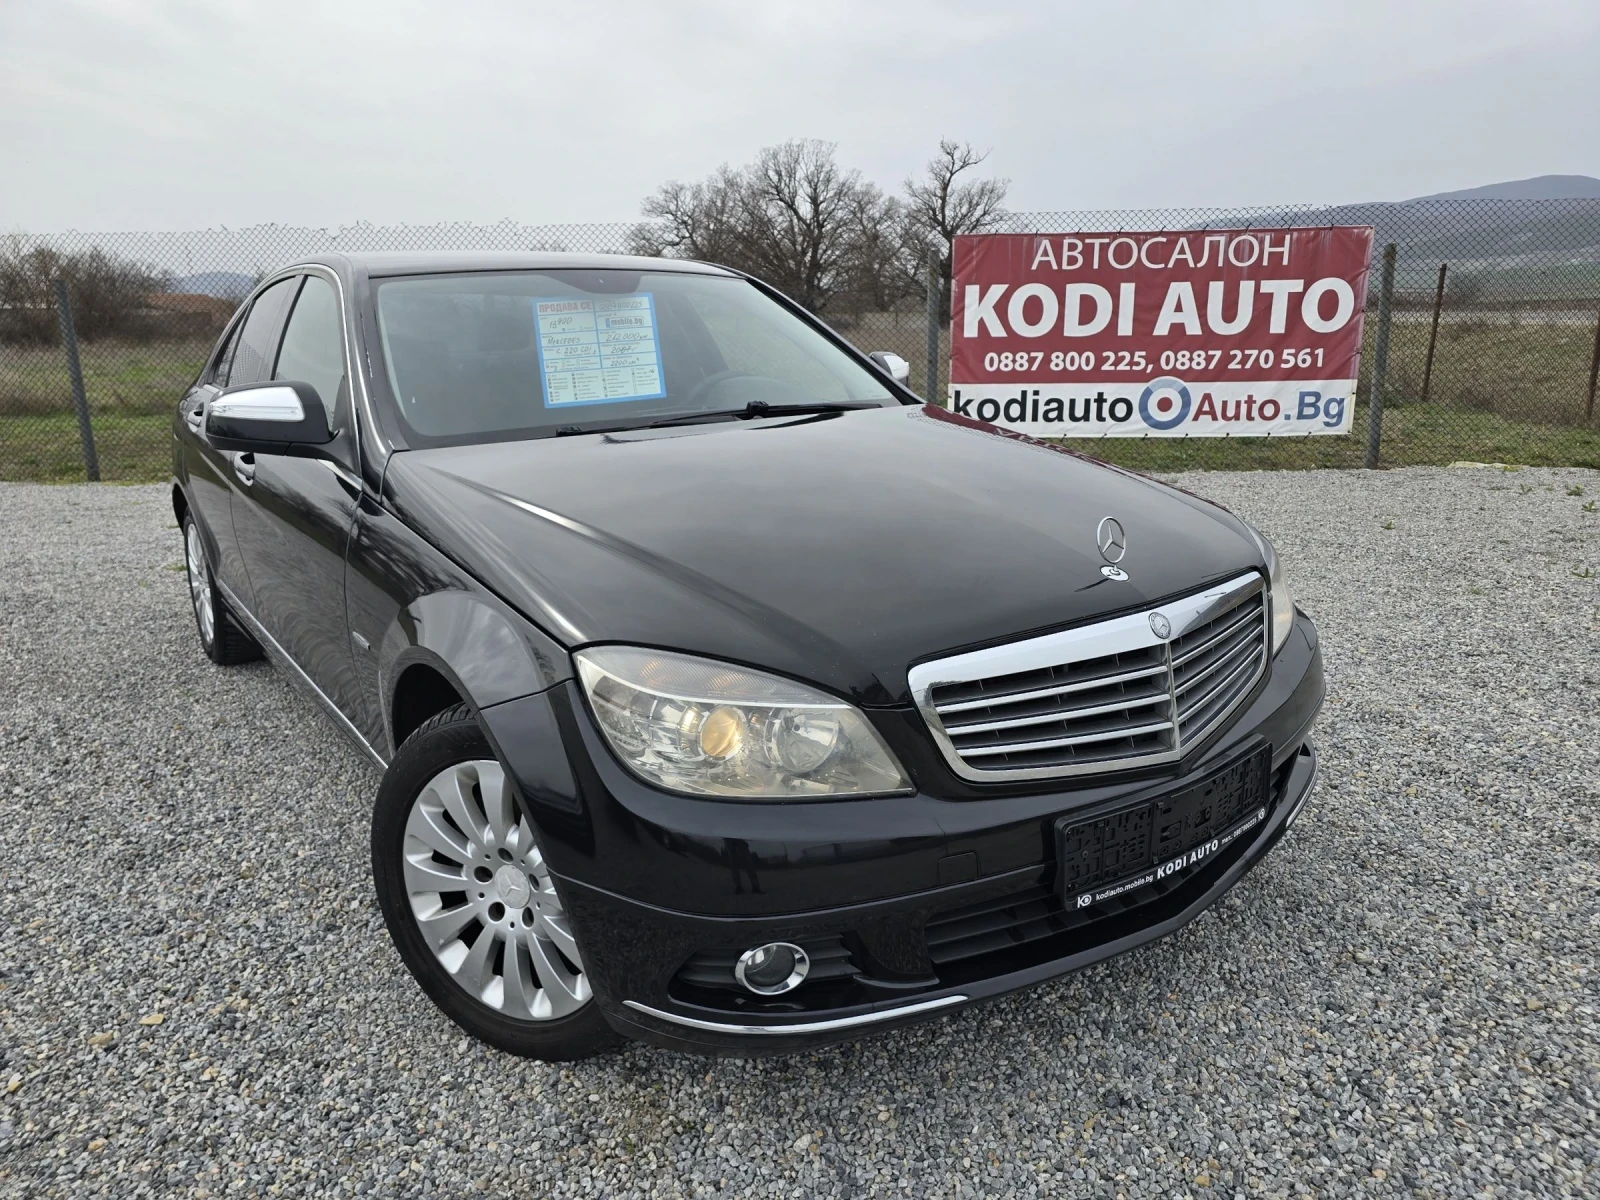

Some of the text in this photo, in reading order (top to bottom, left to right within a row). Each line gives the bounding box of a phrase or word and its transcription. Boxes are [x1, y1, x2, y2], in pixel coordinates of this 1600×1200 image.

[1030, 234, 1292, 271] АВТОСАЛОН
[538, 301, 592, 313] ПРОДАВА СЕ
[610, 317, 643, 327] mobile.bg
[963, 277, 1355, 338] KODI AUTO
[984, 348, 1325, 374] 0887 800 225, 0887 270 561
[954, 389, 1134, 424] kodiauto
[1095, 873, 1154, 902] kodiauto.mobile.bg
[1157, 855, 1187, 880] KODI
[1189, 839, 1219, 864] AUTO
